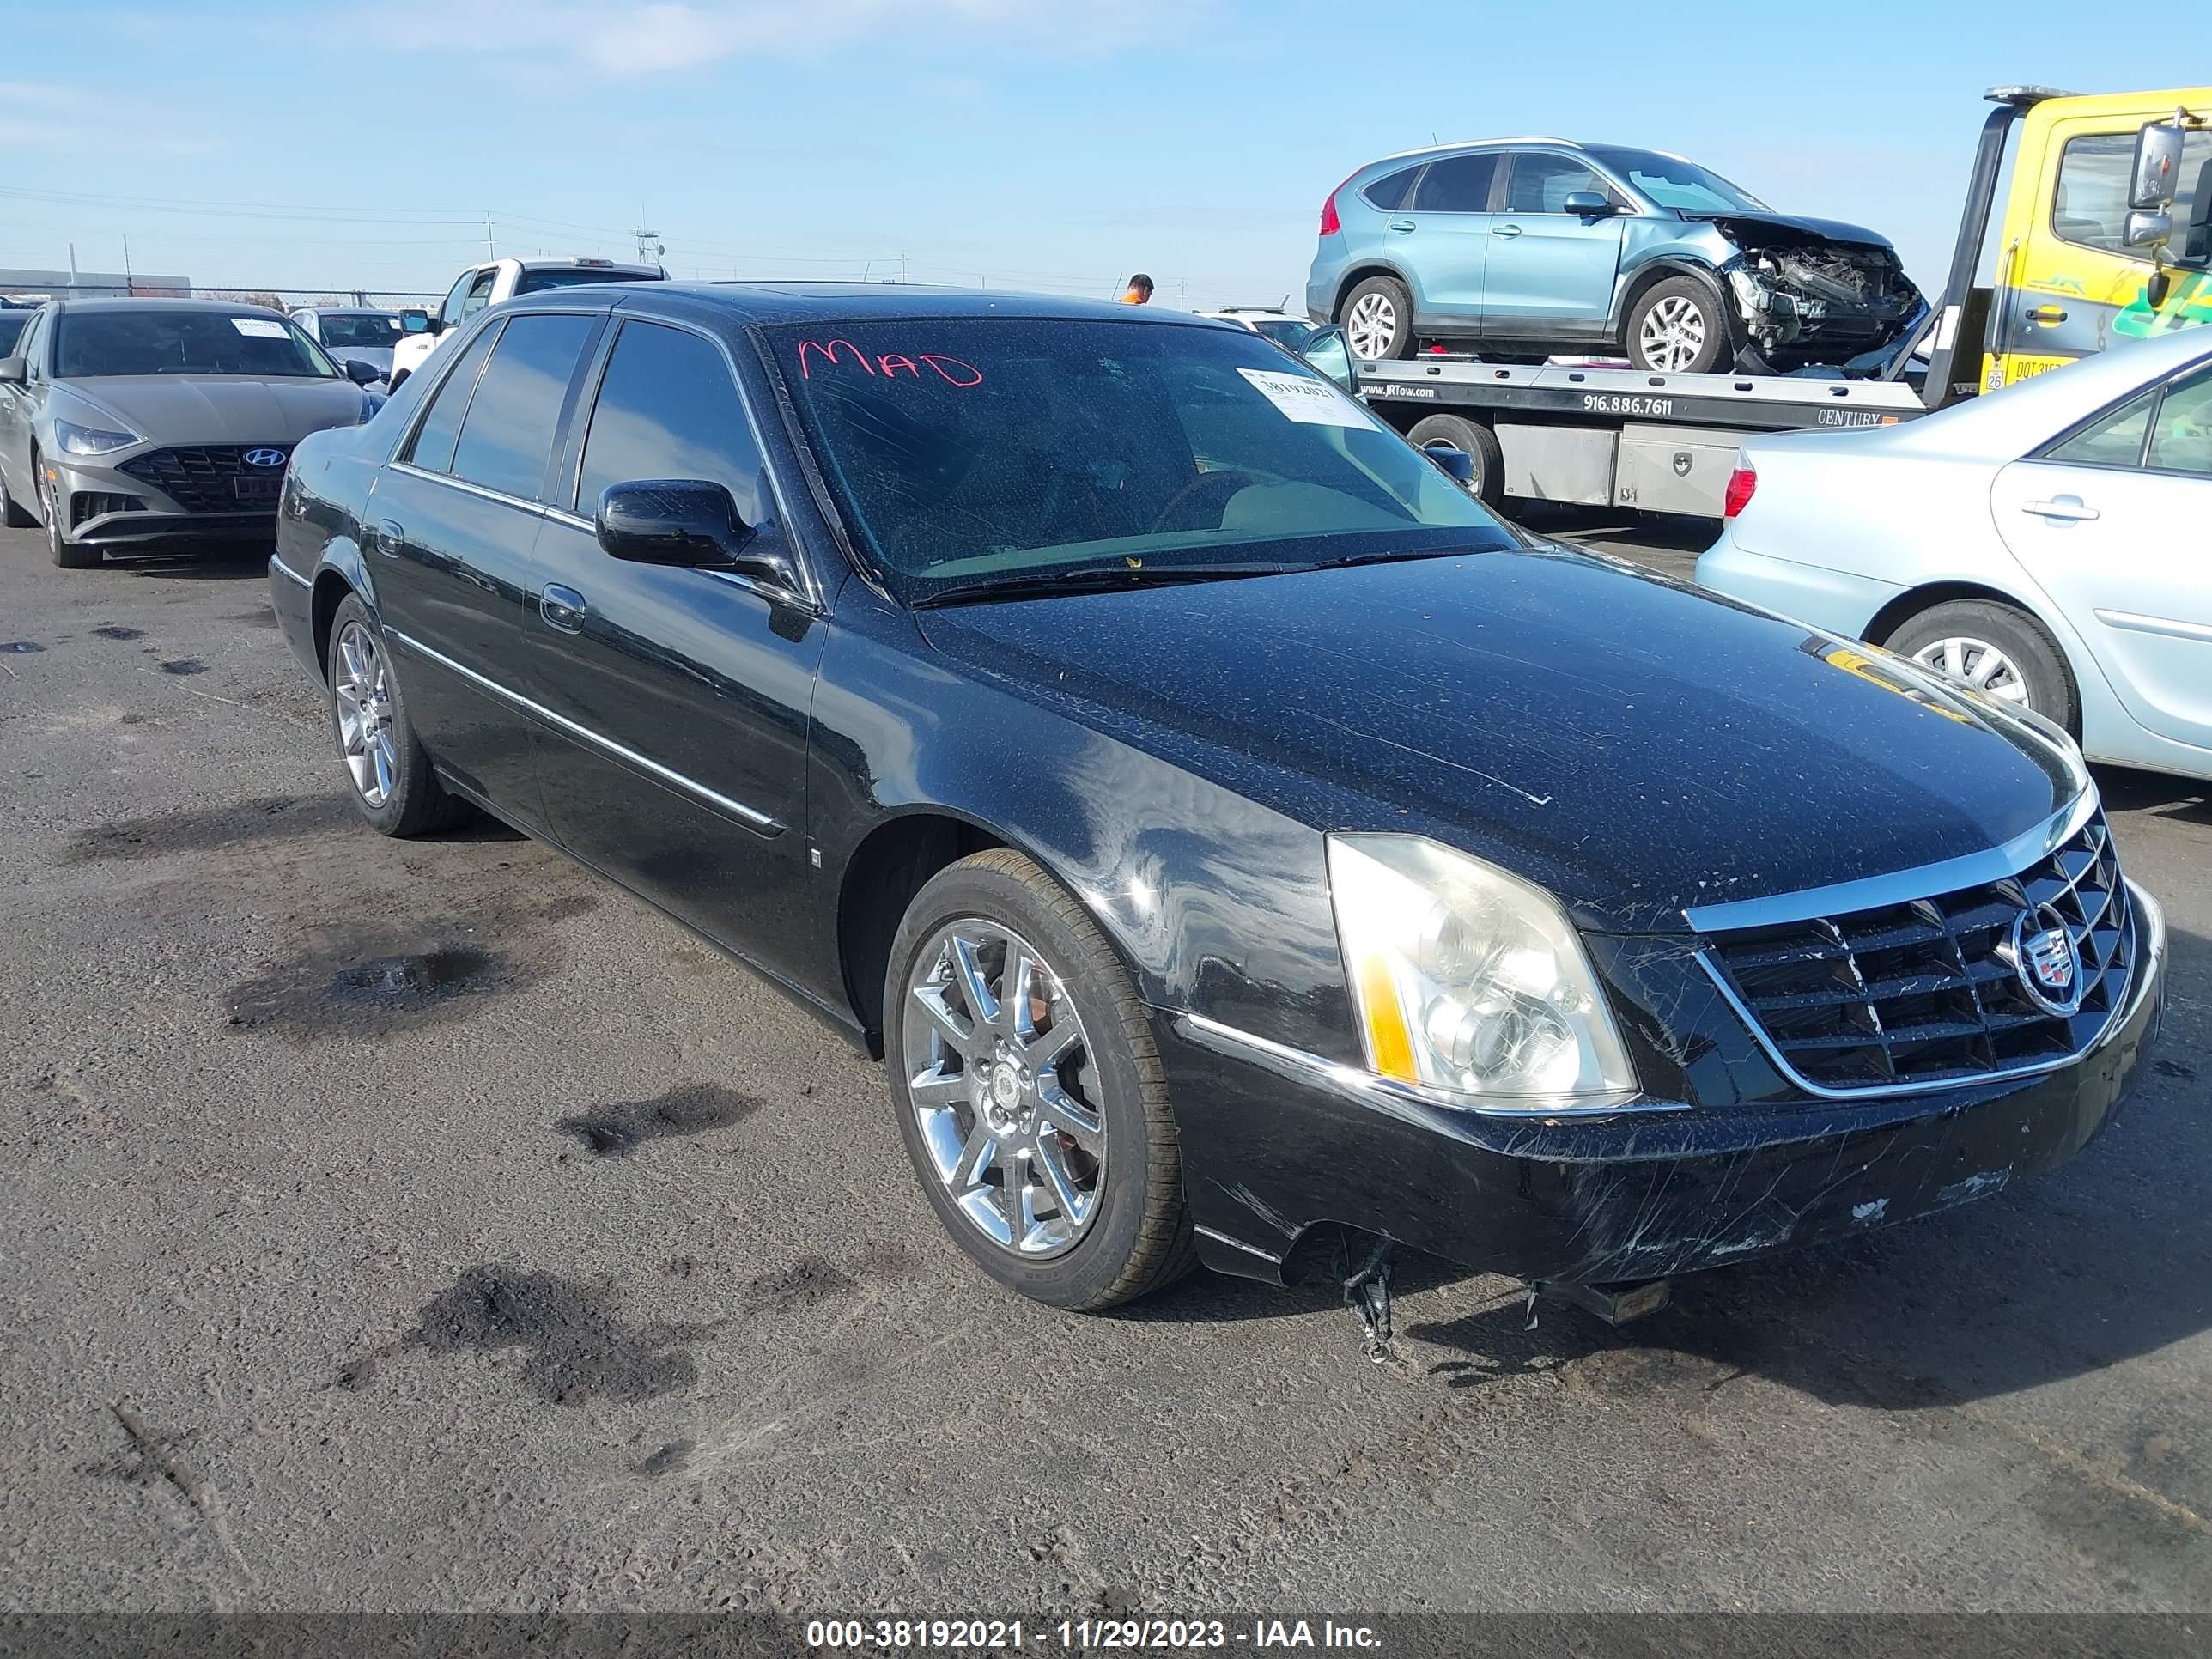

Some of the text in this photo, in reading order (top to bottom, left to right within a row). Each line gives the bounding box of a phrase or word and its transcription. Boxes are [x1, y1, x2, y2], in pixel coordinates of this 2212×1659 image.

[798, 339, 983, 386] MAD
[2016, 362, 2037, 379] DOT
[1260, 380, 1336, 399] 38192021
[1988, 375, 2002, 388] 26
[1360, 384, 1435, 398] www.JRTow.com
[1583, 394, 1673, 416] 916.886.7611
[1818, 409, 1881, 427] CENTURY
